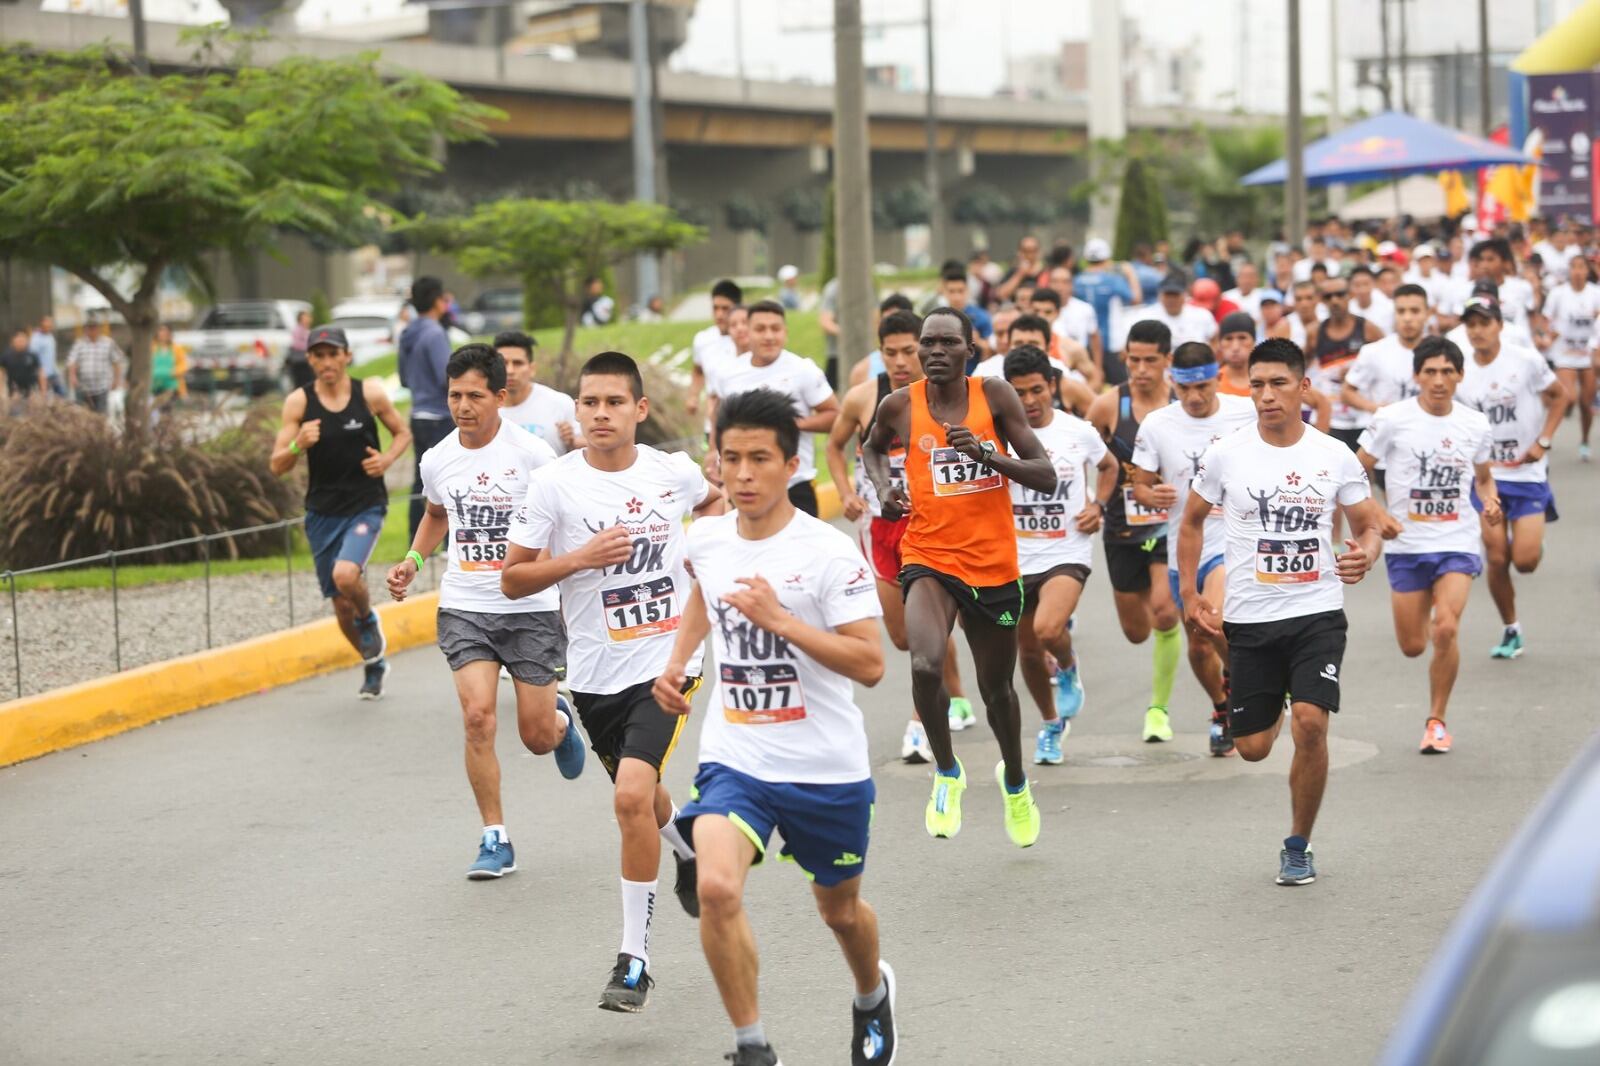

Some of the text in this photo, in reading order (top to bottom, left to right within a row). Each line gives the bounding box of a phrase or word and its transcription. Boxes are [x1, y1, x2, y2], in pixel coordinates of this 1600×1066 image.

[1487, 404, 1517, 425] 10K
[940, 462, 993, 483] 1374
[1428, 464, 1466, 487] 10K
[470, 495, 513, 503] Plaza Norte
[1278, 494, 1326, 505] Plaza Norte
[1414, 500, 1455, 515] 1086
[467, 504, 513, 528] 10K
[1305, 505, 1324, 513] corre
[648, 523, 671, 534] Norte
[1018, 516, 1061, 530] 1080
[1271, 505, 1322, 533] 10K
[650, 533, 669, 542] corre
[461, 543, 507, 562] 1358
[1263, 554, 1314, 573] 1360
[613, 597, 671, 628] 1157
[734, 621, 798, 660] 10K
[729, 686, 791, 711] 1077
